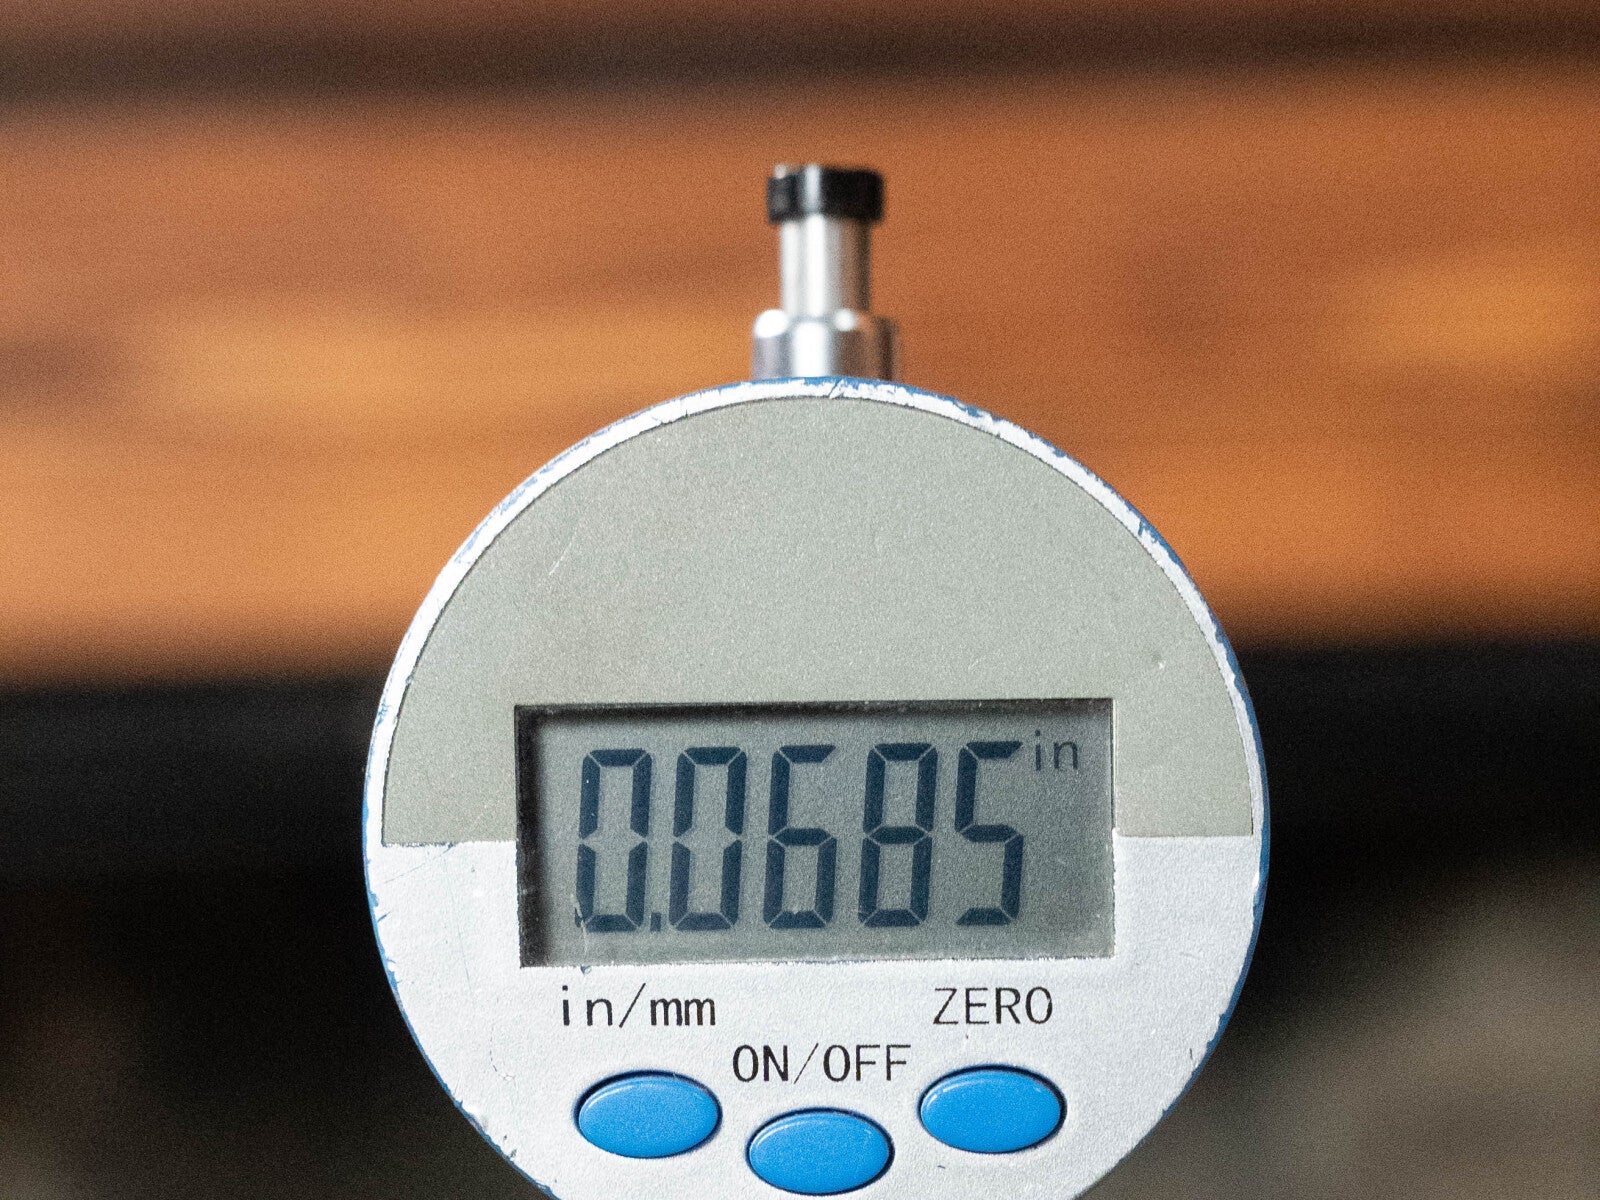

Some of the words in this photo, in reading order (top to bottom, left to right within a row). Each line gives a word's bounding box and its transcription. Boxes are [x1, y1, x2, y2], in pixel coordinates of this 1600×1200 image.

[575, 741, 1024, 933] 0.0685
[1033, 729, 1079, 772] in
[561, 982, 717, 1029] in/mm
[932, 986, 1054, 1026] ZERO
[732, 1042, 912, 1085] ON/OFF
